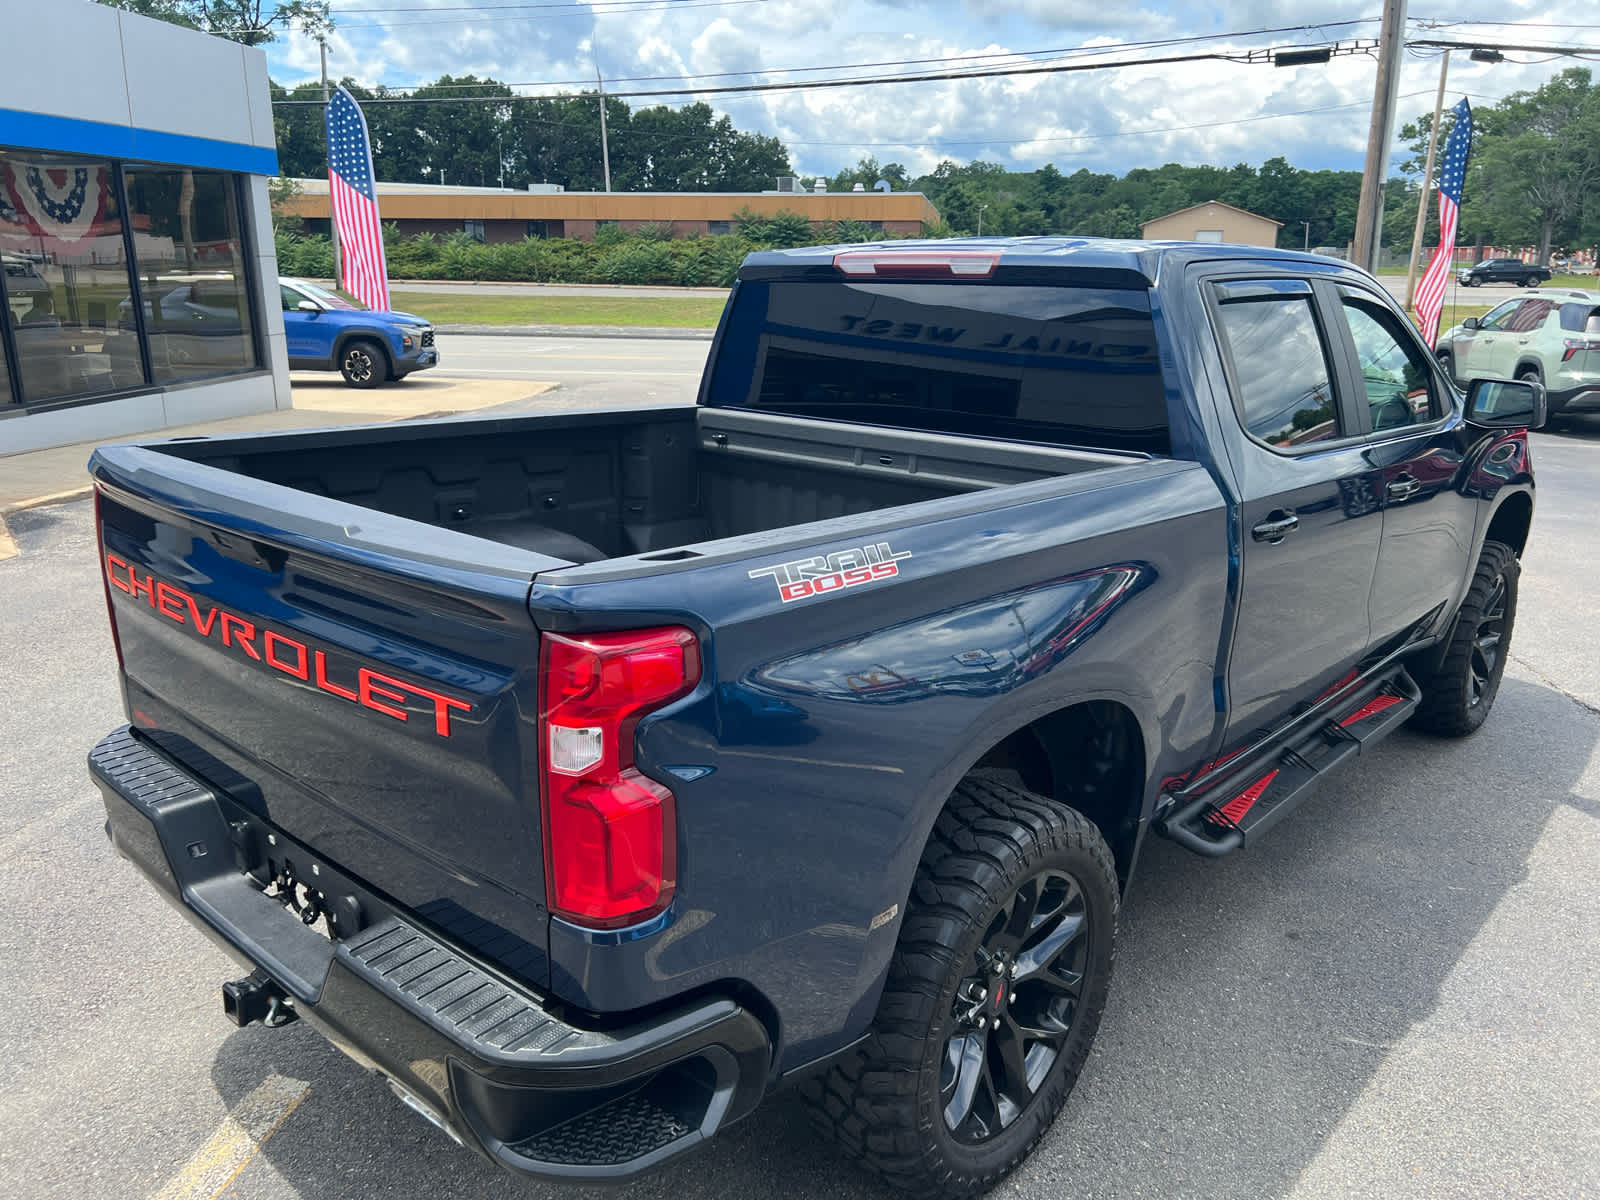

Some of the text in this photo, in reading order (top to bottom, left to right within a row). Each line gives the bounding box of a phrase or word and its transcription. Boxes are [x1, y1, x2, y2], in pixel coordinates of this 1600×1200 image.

[748, 542, 912, 587] TRAIL
[779, 560, 899, 604] BOSS
[106, 553, 473, 738] CHEVROLET
